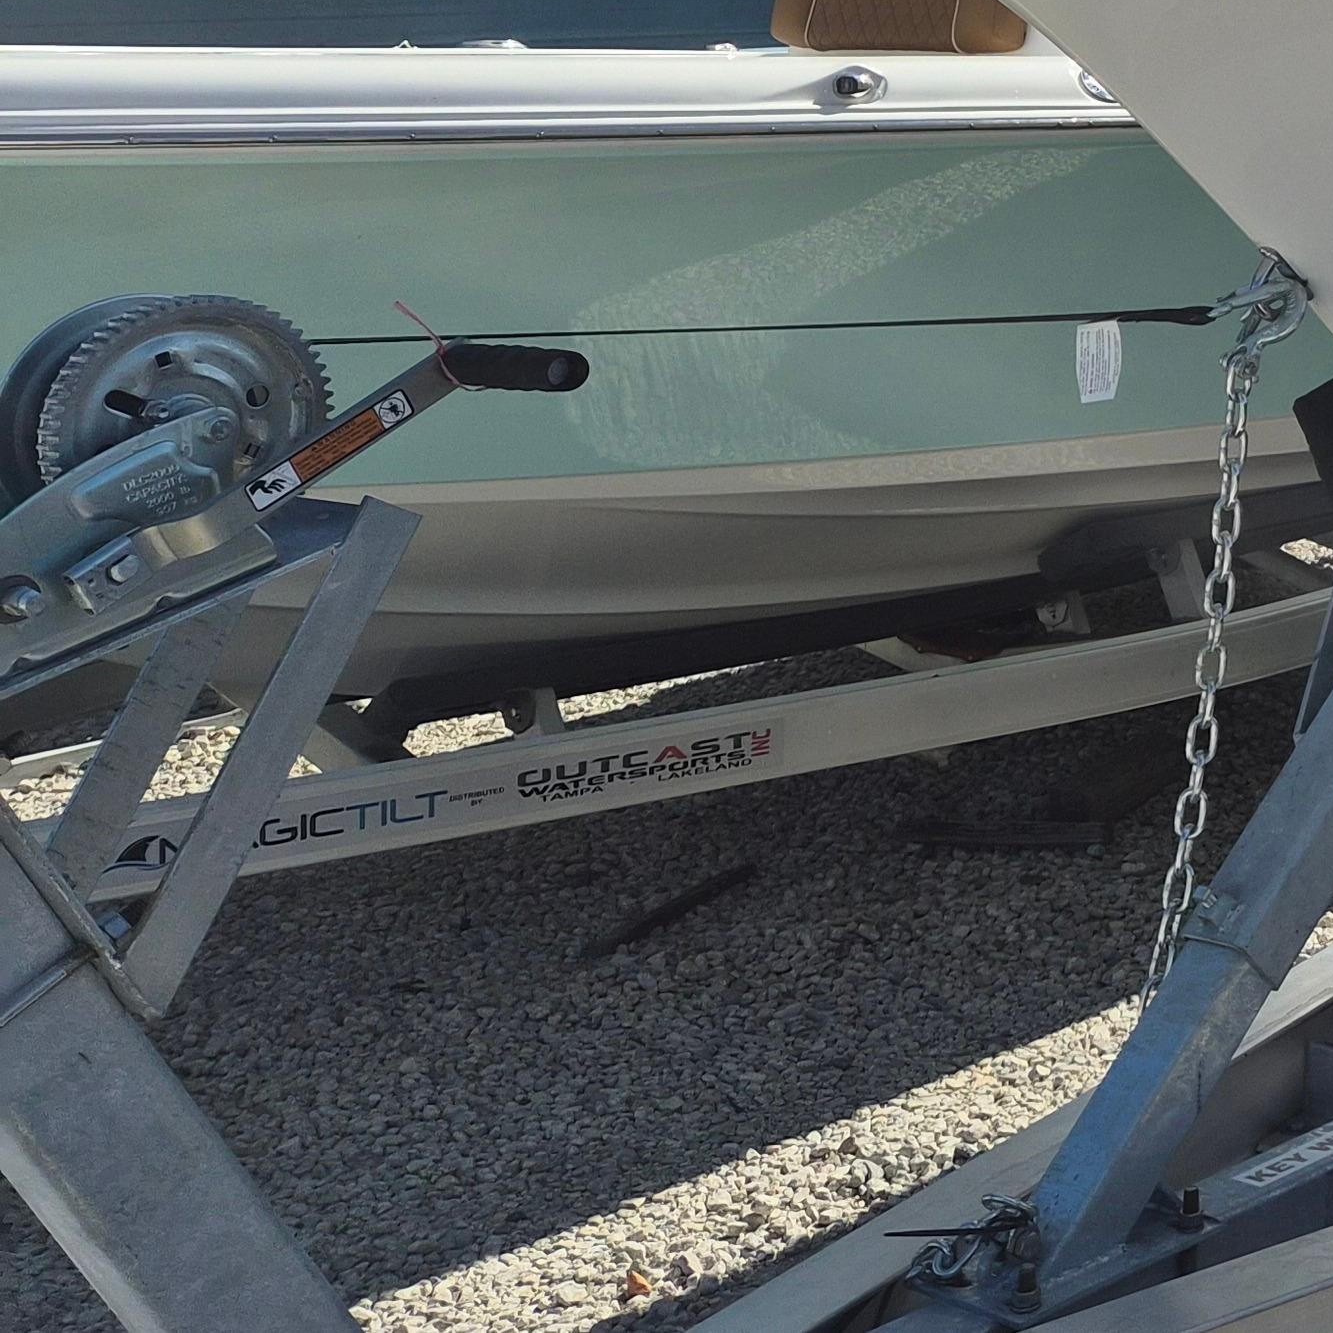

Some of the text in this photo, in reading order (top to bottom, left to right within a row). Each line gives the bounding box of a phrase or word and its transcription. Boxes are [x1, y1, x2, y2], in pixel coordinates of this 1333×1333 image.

[146, 492, 175, 509] 2000
[517, 728, 772, 787] OUTCAST INC
[518, 749, 746, 799] WATERSPORTS
[541, 757, 752, 803] TAMPA LAKELAND
[449, 786, 504, 802] DISTRIBUTED
[470, 797, 483, 807] BY
[1244, 1152, 1309, 1183] KEY
